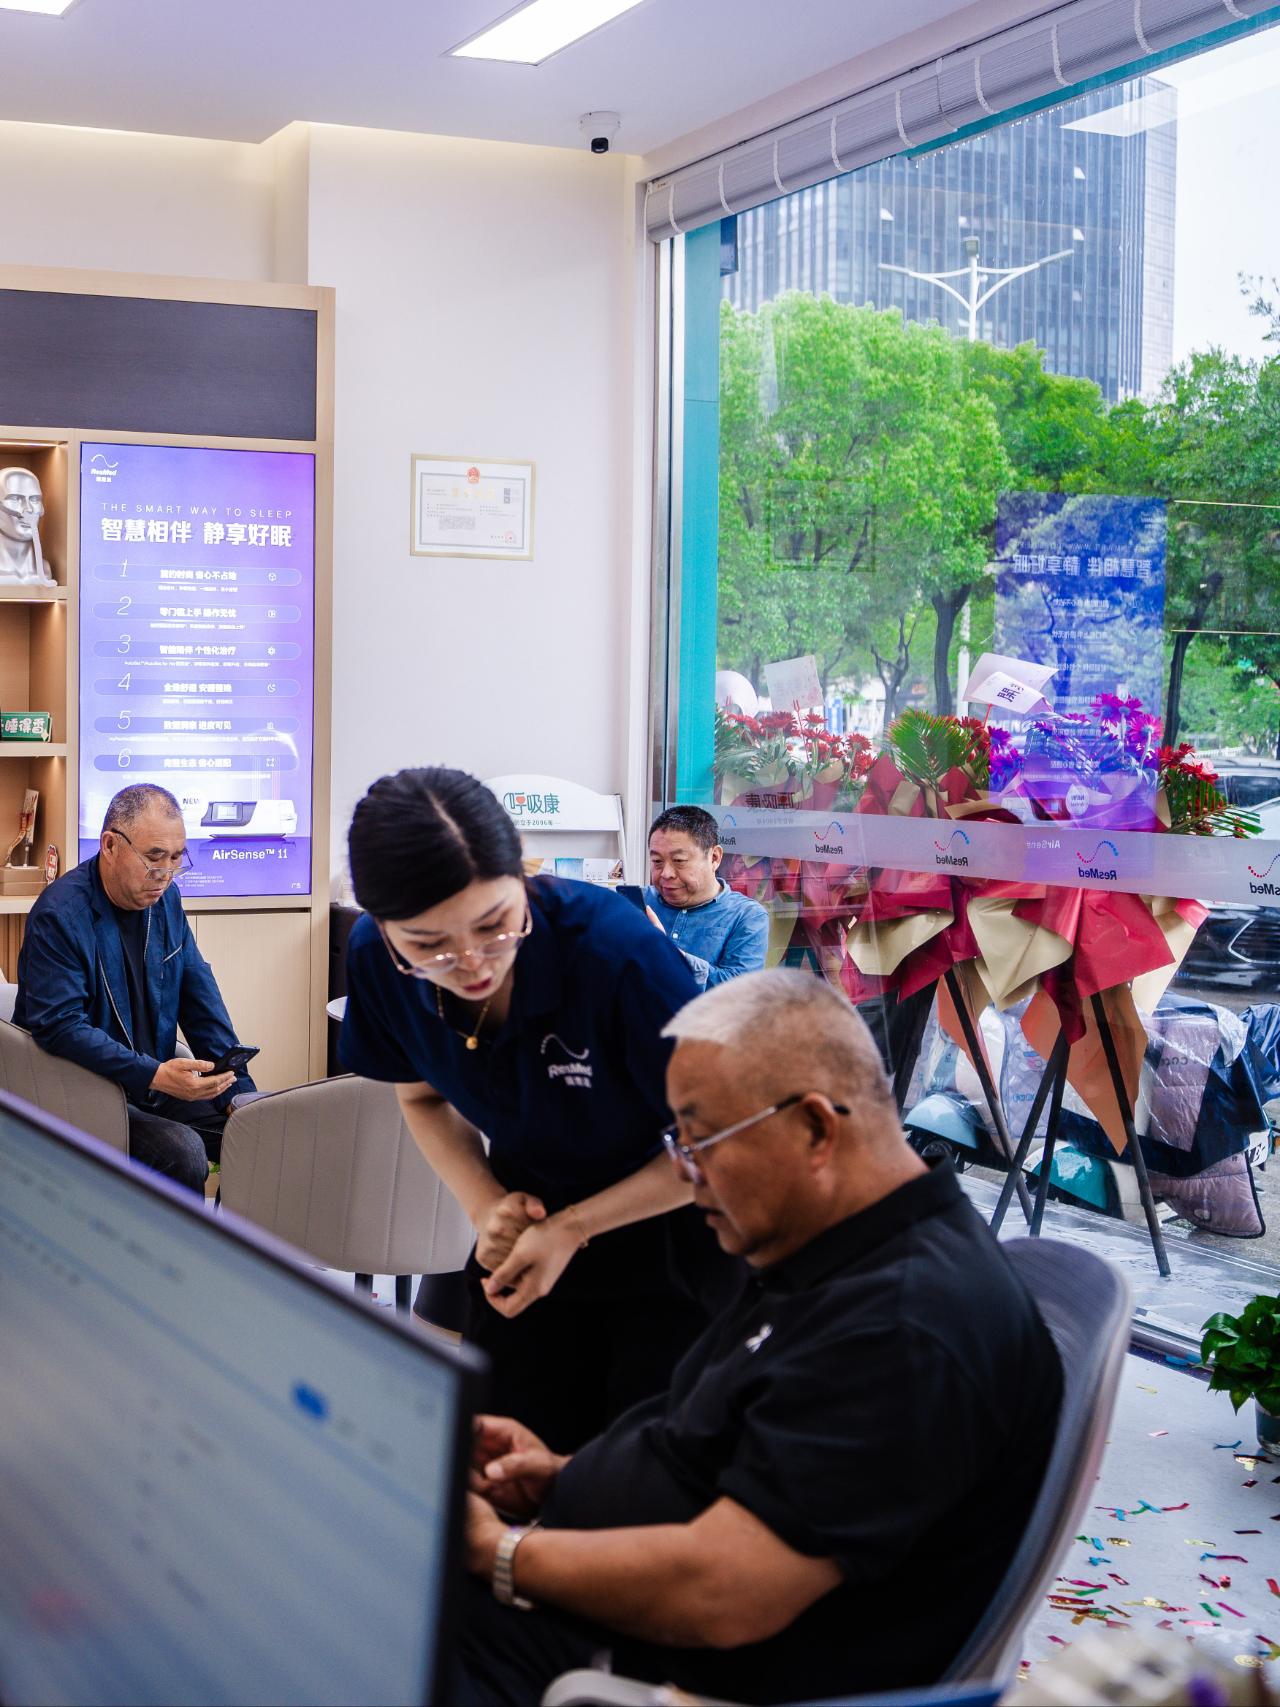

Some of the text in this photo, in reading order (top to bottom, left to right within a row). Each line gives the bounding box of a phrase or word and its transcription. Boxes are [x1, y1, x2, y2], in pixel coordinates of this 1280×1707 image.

[101, 503, 293, 519] THE SMART WAY TO SLEEP
[101, 517, 293, 547] 智慧相伴 静享好眠
[120, 559, 128, 577] 1
[117, 596, 132, 616] 2
[117, 634, 132, 654] 3
[117, 673, 132, 691] 4
[1, 718, 46, 734] 睡得香
[117, 711, 132, 730] 5
[117, 749, 132, 768] 6
[503, 792, 560, 815] 呼吸康
[278, 850, 288, 859] 11
